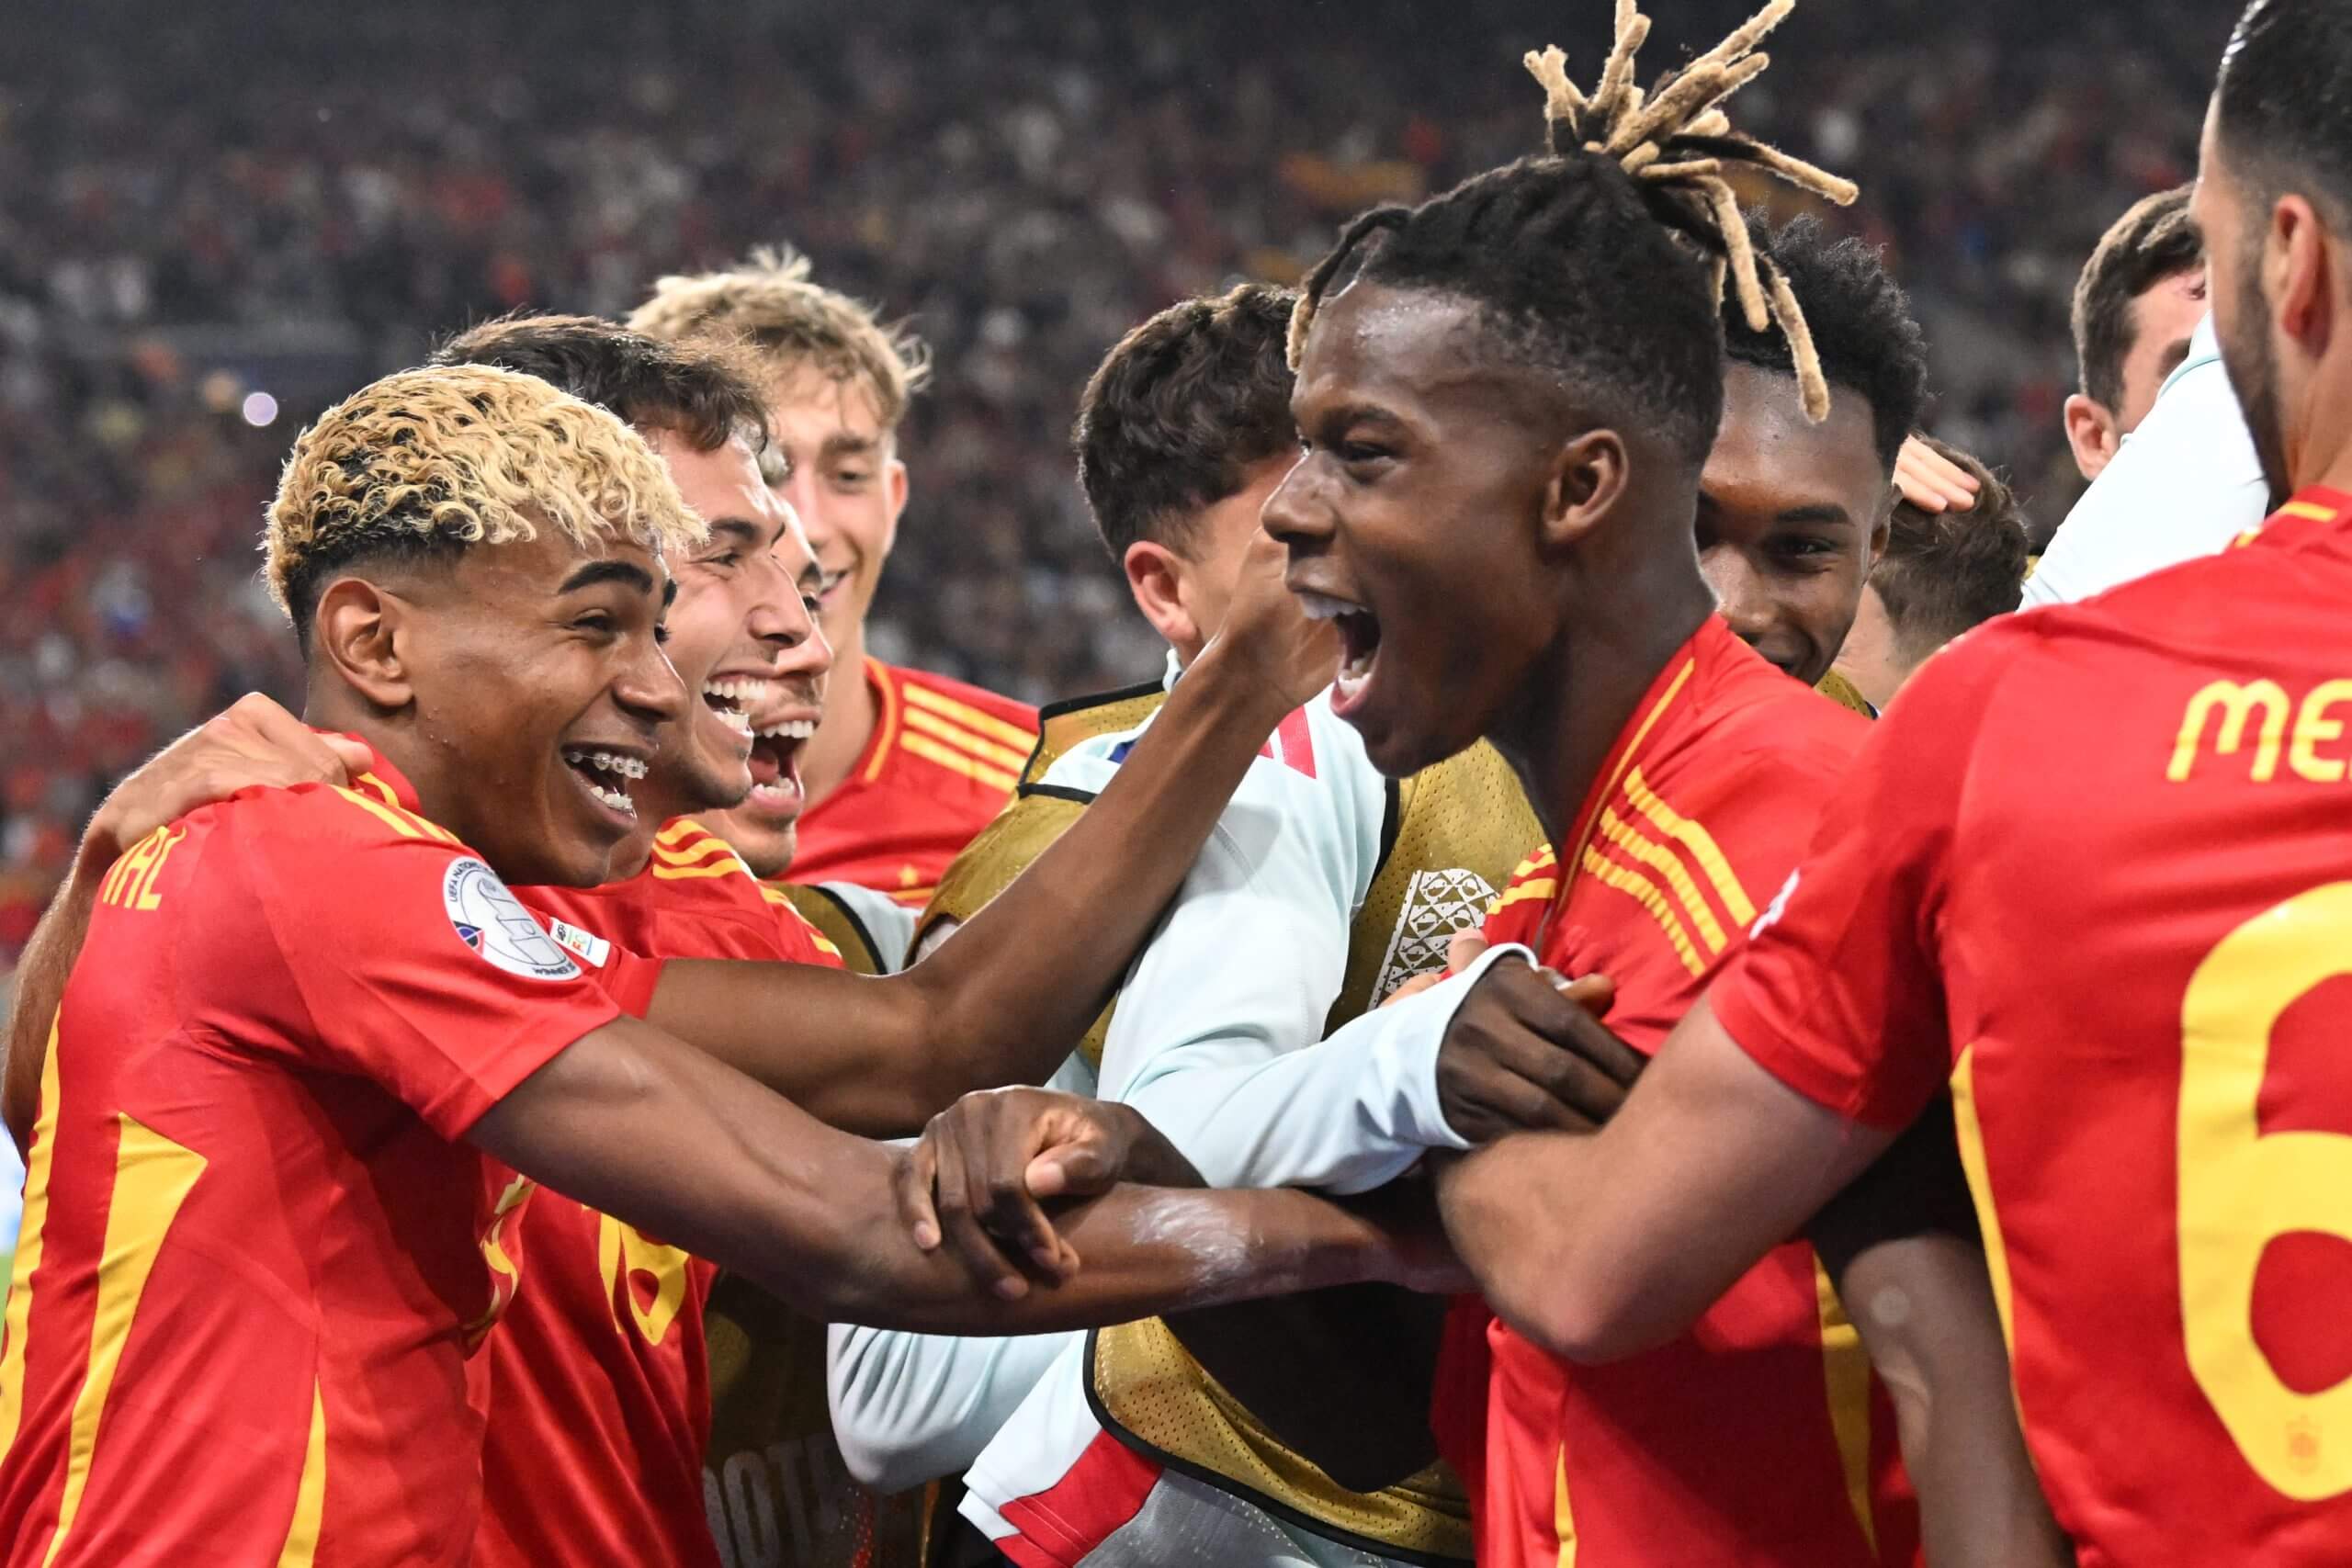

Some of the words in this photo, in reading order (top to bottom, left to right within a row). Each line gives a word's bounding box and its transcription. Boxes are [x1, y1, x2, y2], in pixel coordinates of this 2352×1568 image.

[2167, 678, 2352, 783] ME
[102, 825, 187, 911] AL
[2177, 882, 2352, 1502] 6
